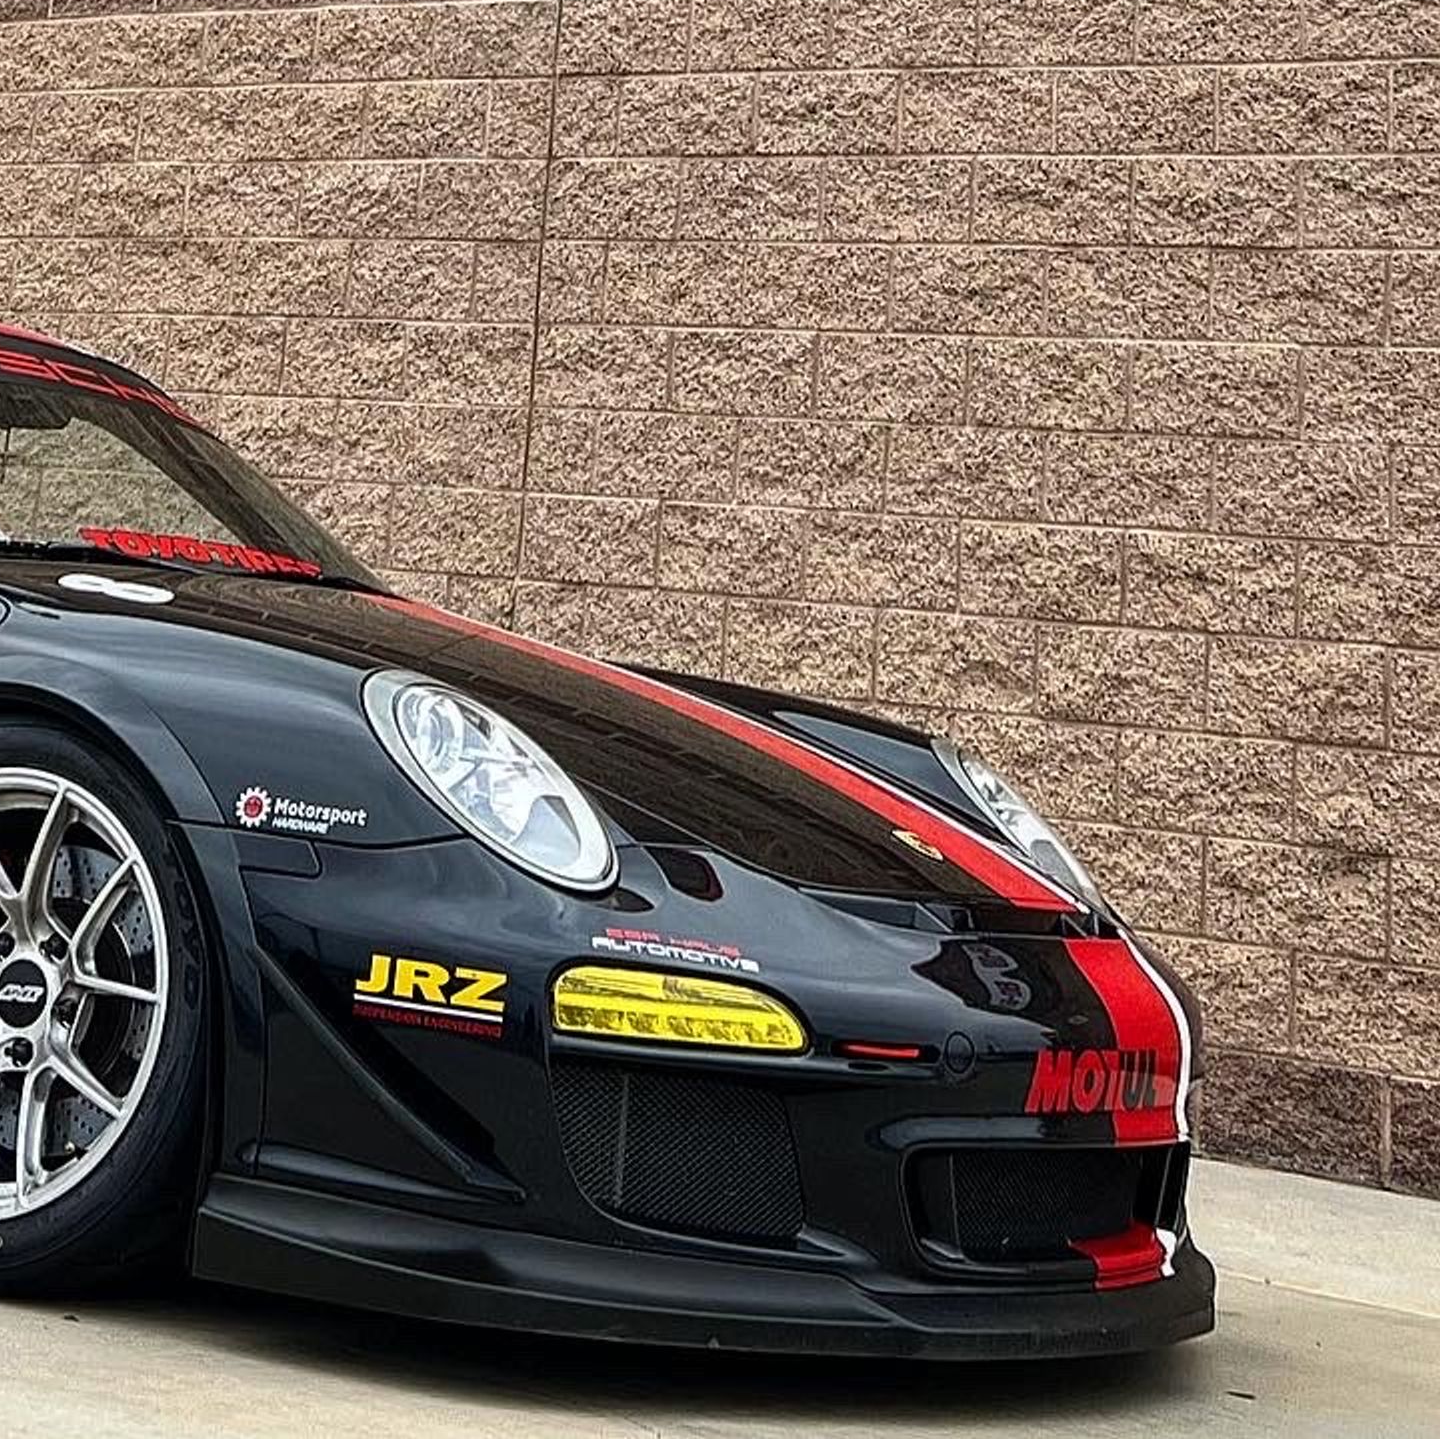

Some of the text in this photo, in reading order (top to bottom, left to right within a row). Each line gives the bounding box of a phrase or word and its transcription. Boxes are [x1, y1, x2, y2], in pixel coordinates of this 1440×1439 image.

[274, 797, 367, 826] Motorsport
[591, 936, 760, 974] AUTOMOTIVE
[355, 954, 508, 1013] JRZ
[1023, 1048, 1160, 1113] MOTUL
